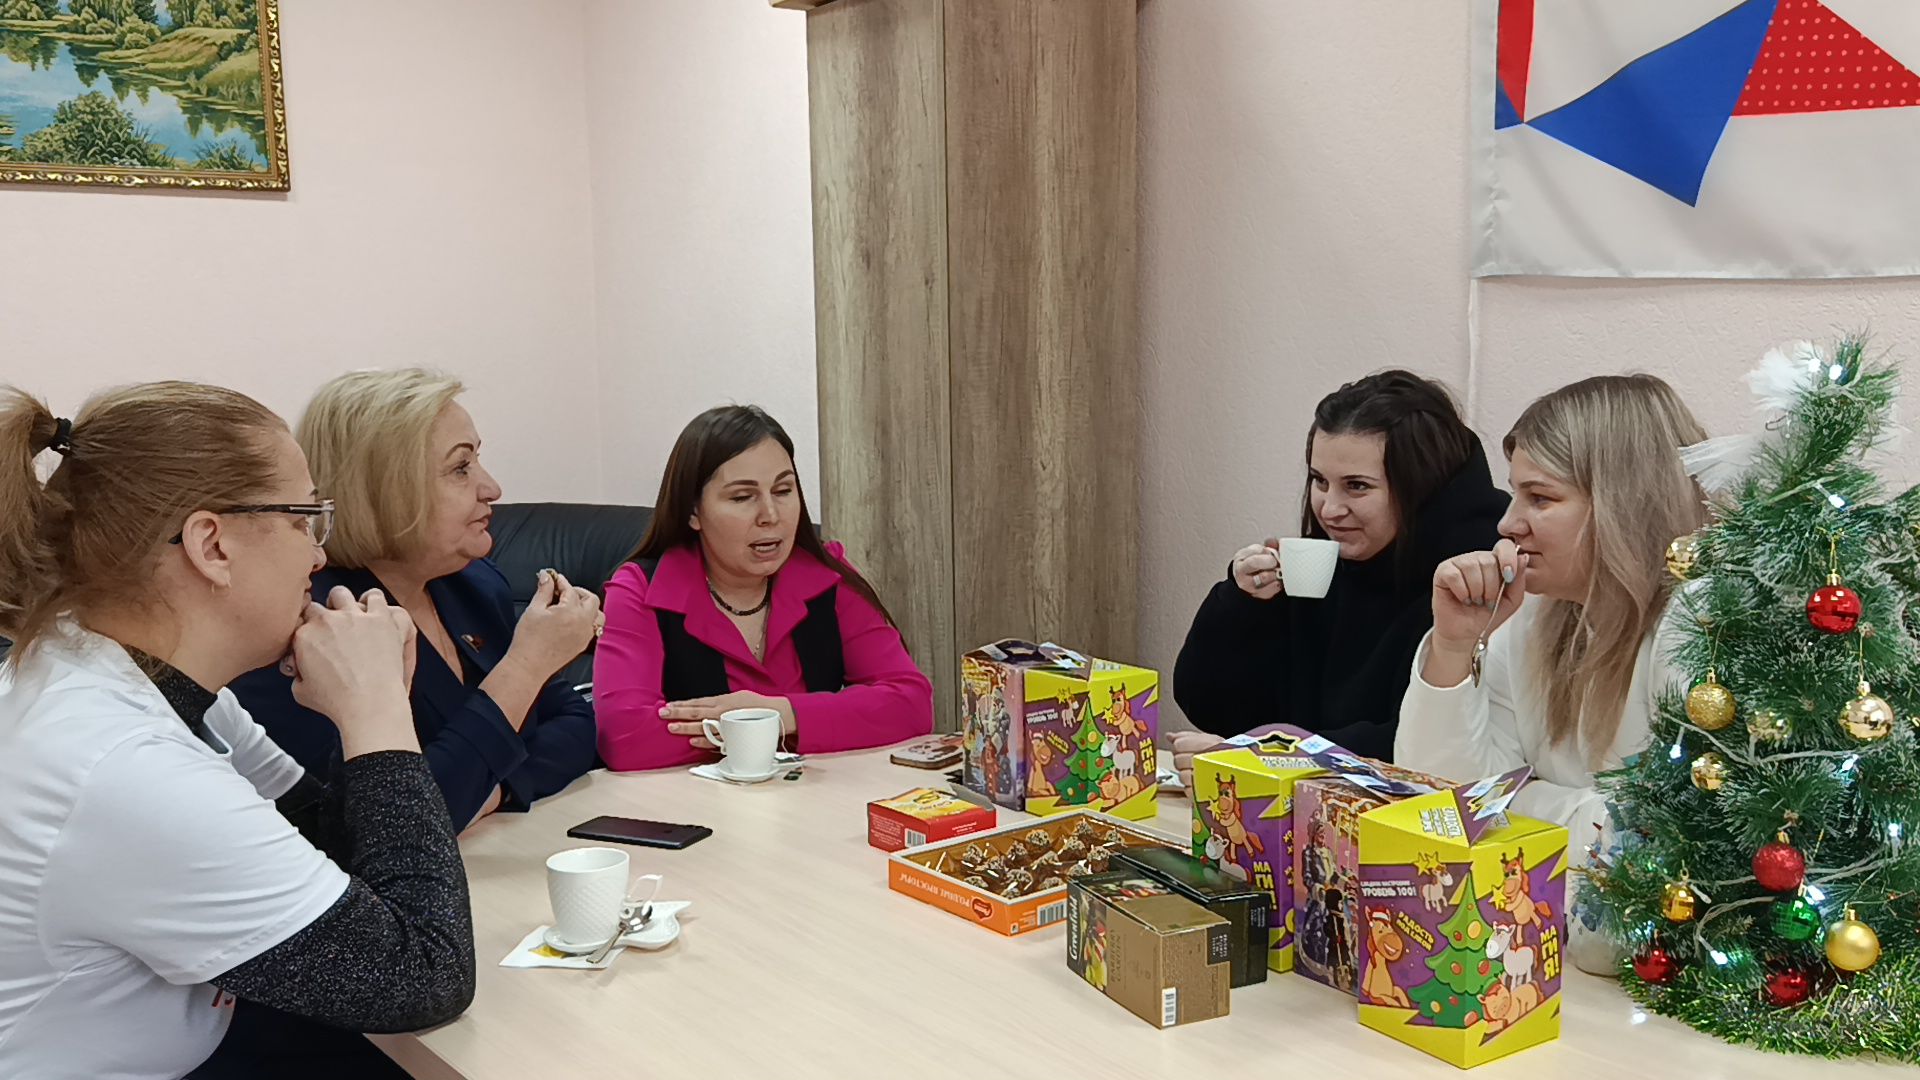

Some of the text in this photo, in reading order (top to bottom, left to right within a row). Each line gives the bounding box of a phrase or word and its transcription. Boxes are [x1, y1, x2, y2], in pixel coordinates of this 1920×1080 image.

[1139, 736, 1152, 749] МА
[1141, 745, 1153, 760] ГИ
[1253, 861, 1271, 873] МА
[1255, 873, 1274, 889] ГИ
[1068, 894, 1078, 960] Greenfield
[1398, 910, 1435, 944] РАДОСТЬ
[1540, 924, 1557, 945] МА
[1541, 936, 1558, 961] ГИ
[1544, 952, 1560, 981] Я!
